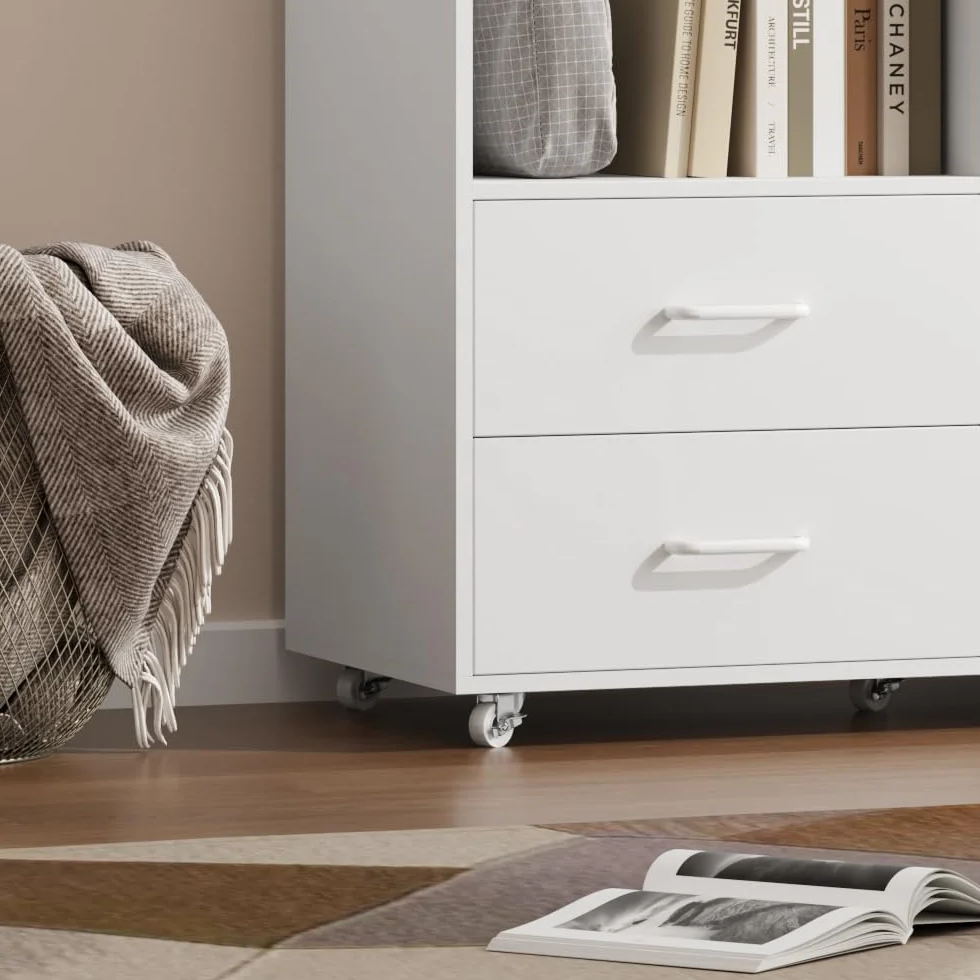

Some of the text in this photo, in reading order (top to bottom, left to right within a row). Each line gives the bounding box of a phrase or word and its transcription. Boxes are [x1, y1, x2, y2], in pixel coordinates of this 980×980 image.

[682, 9, 694, 37] GUIDE
[854, 8, 872, 52] Paris
[680, 40, 692, 51] TO
[889, 4, 905, 114] CHANEY
[679, 53, 691, 79] HOME
[676, 82, 688, 117] DESIGN
